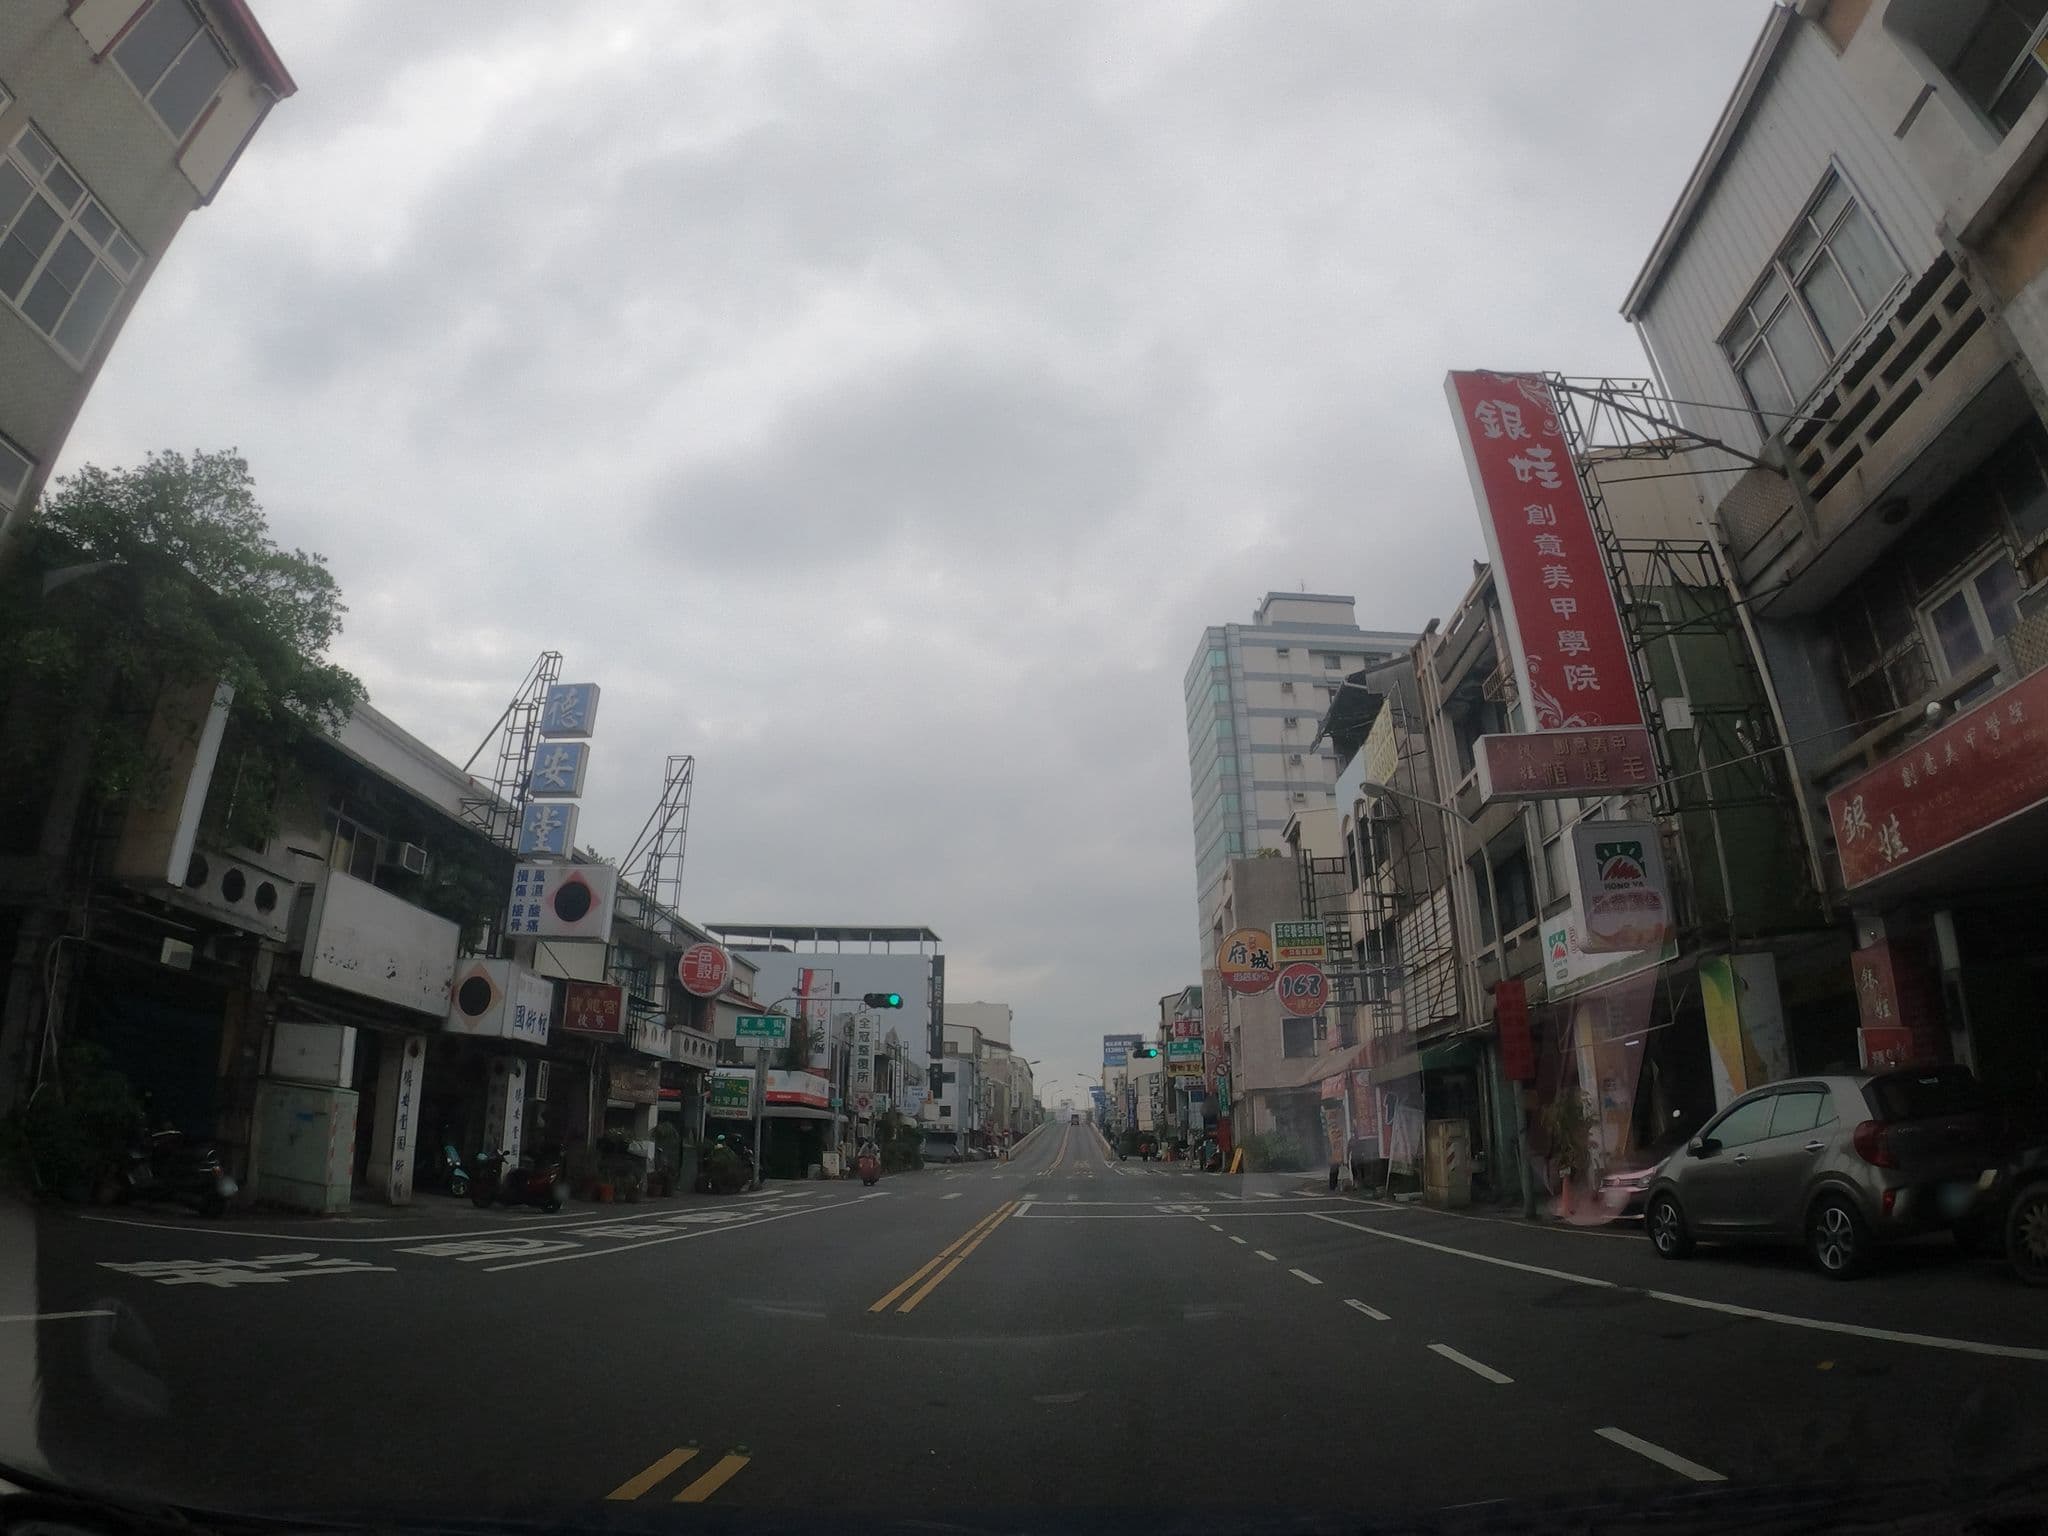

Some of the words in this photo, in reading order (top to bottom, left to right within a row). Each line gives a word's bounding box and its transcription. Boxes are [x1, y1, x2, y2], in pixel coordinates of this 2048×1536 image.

[1523, 502, 1601, 692] 創意美甲學院
[527, 687, 583, 852] 德安堂
[1228, 940, 1275, 971] 府城
[1282, 974, 1321, 998] 168
